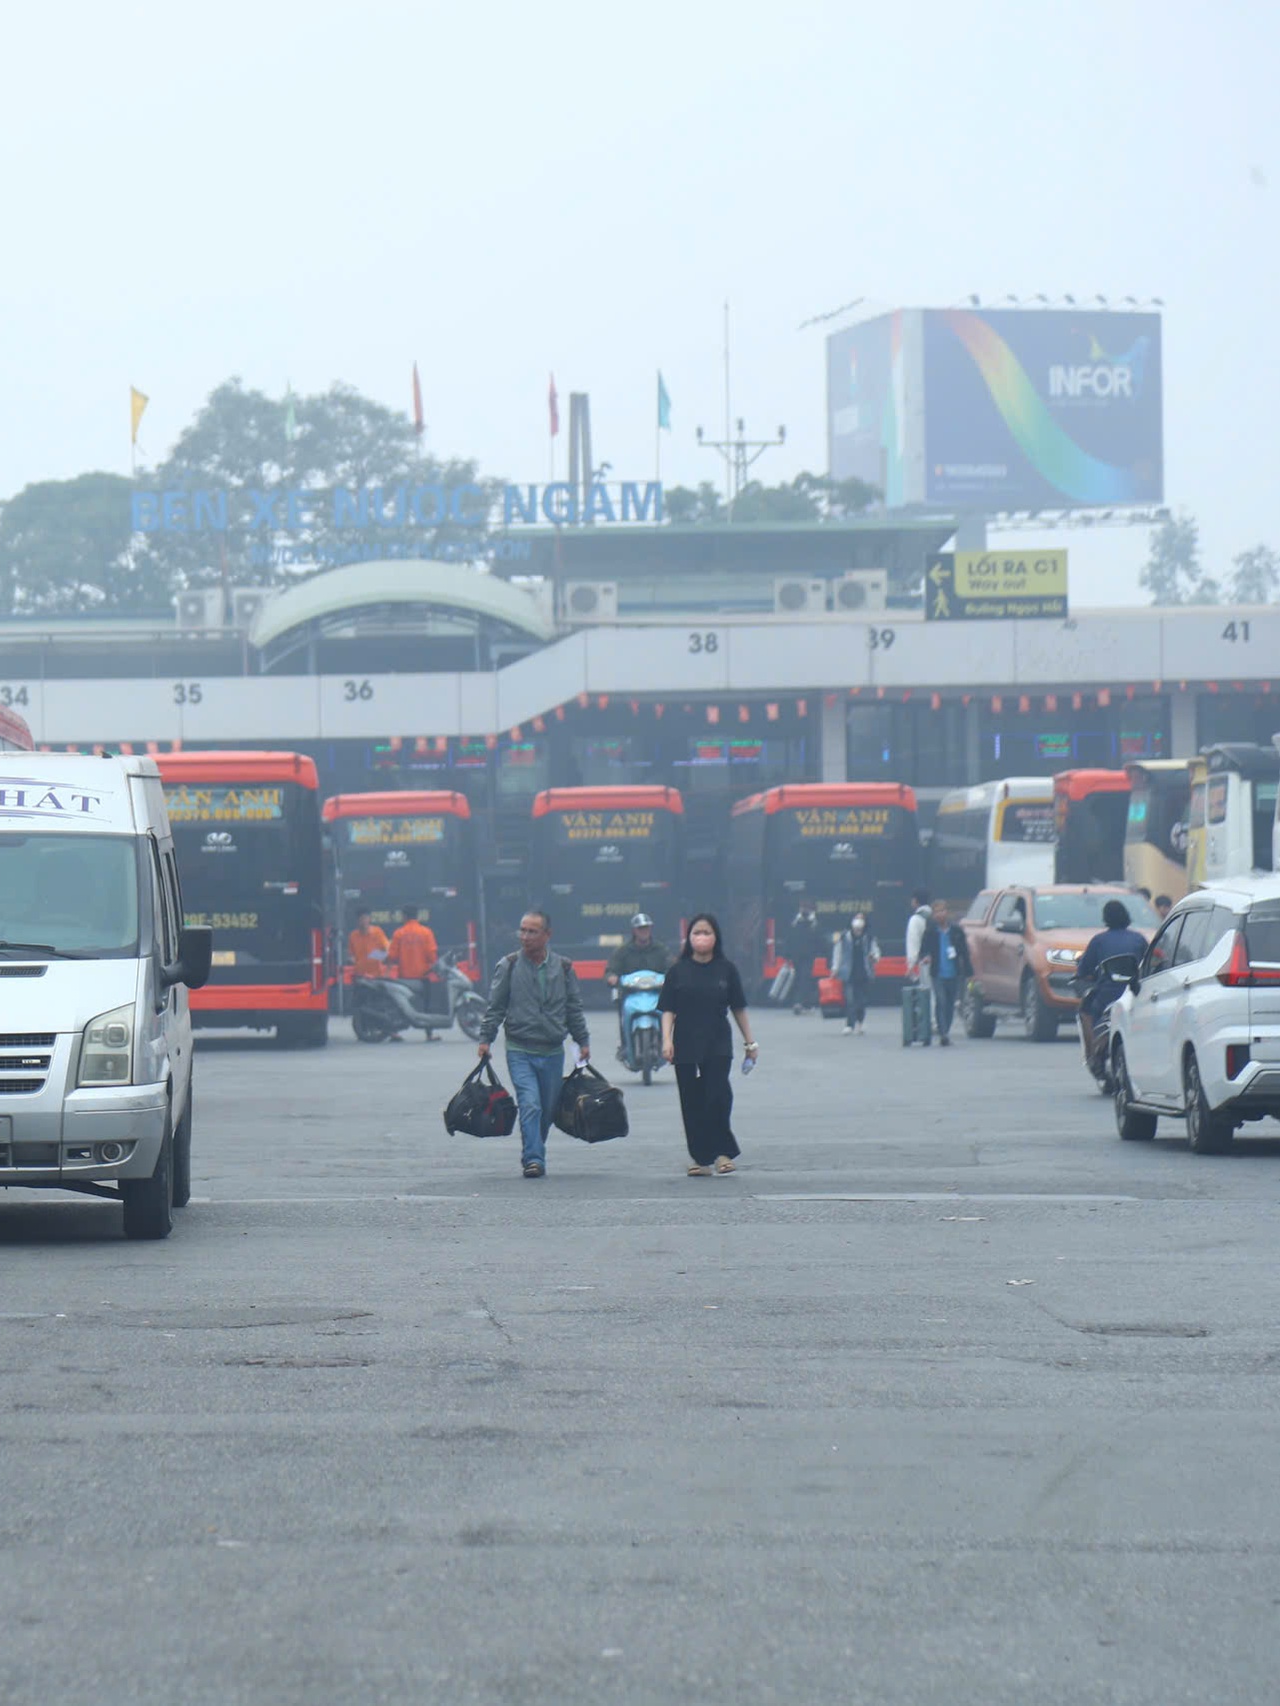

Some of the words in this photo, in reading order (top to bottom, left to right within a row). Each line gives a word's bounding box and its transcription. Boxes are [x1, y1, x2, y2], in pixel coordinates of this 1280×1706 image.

[1048, 364, 1133, 397] INFOR
[249, 487, 317, 529] XE
[968, 555, 997, 576] LỐI
[1003, 560, 1027, 575] RA
[1033, 558, 1058, 574] C1
[866, 628, 896, 650] 39
[1222, 621, 1251, 642] 41
[688, 632, 718, 654] 38
[0, 685, 29, 706] 34
[173, 684, 202, 704] 35
[344, 680, 373, 701] 36
